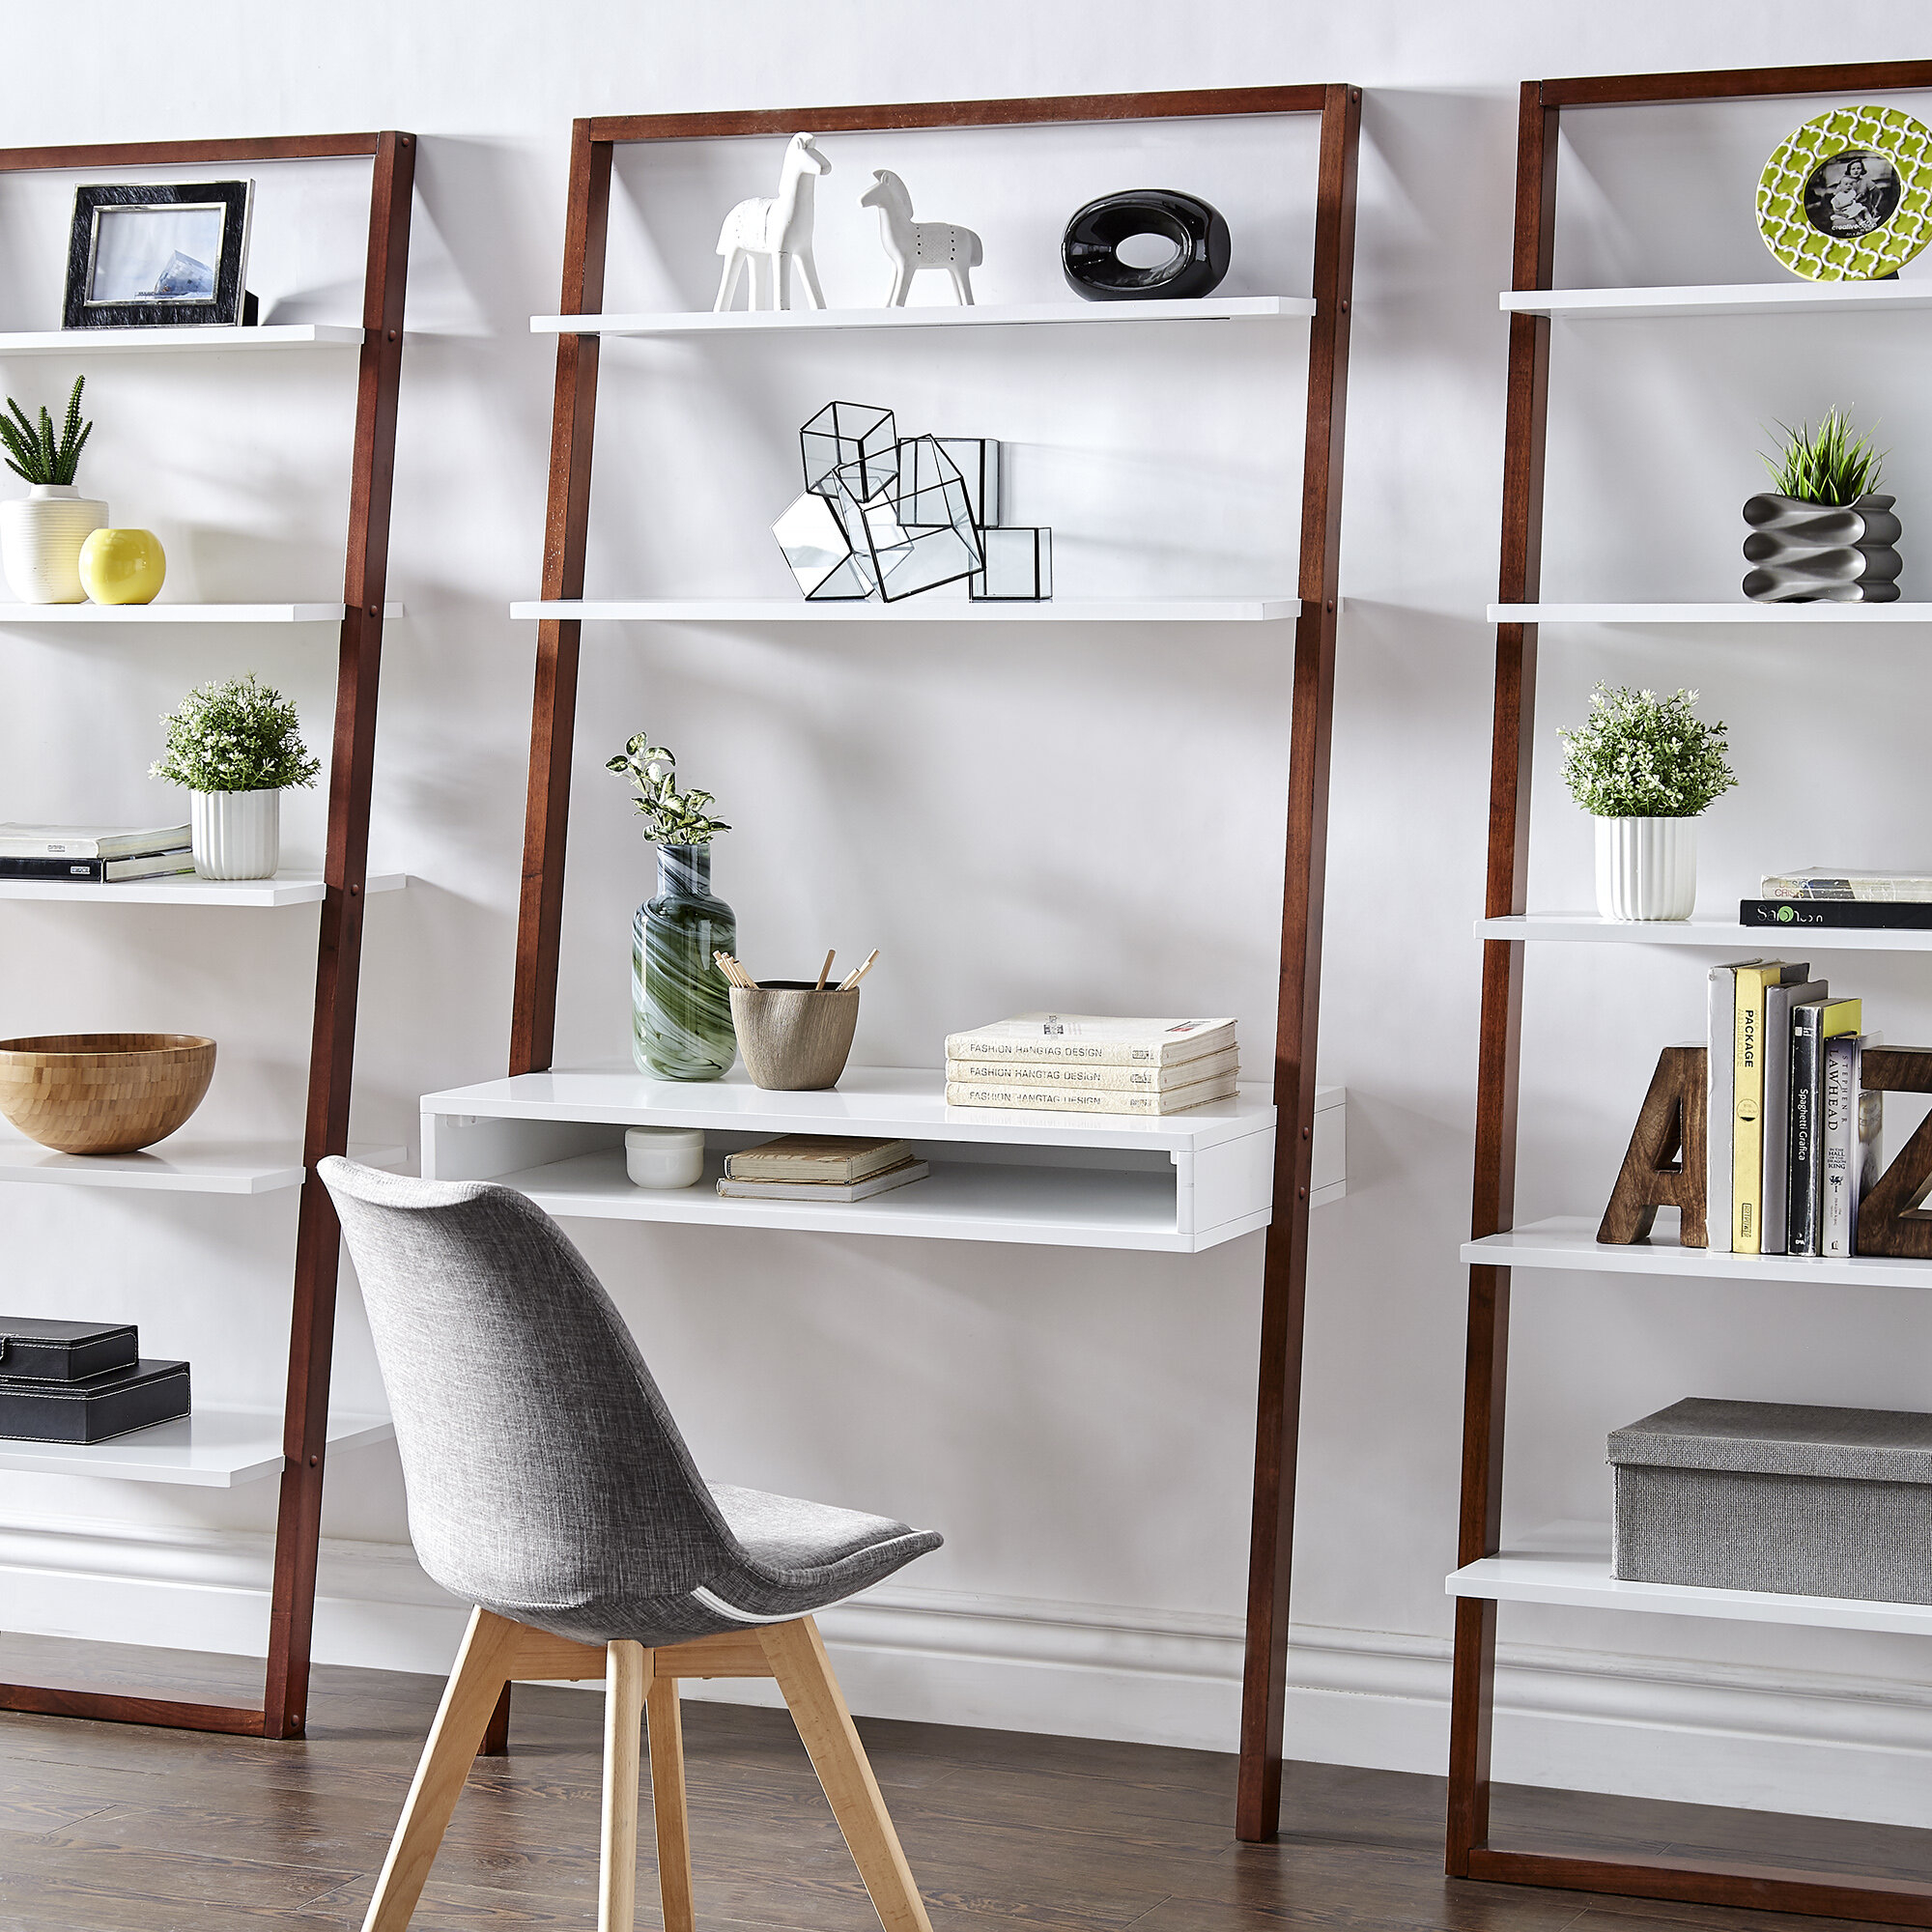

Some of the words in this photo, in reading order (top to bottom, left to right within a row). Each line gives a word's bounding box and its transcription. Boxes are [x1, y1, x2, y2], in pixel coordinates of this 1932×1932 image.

[970, 1043, 1012, 1054] FASHION
[1015, 1045, 1062, 1056] HANGTAG
[1065, 1047, 1102, 1058] DESIGN
[1745, 1009, 1754, 1067] PACKAGE
[970, 1067, 1011, 1077] FASHION
[1014, 1069, 1061, 1080] HANGTAG
[1064, 1071, 1101, 1081] DESIGN
[969, 1091, 1011, 1102] FASHION
[1828, 1049, 1842, 1131] LAWHEAD
[1797, 1088, 1809, 1129] Spaghetti
[1798, 1130, 1808, 1161] Grafica
